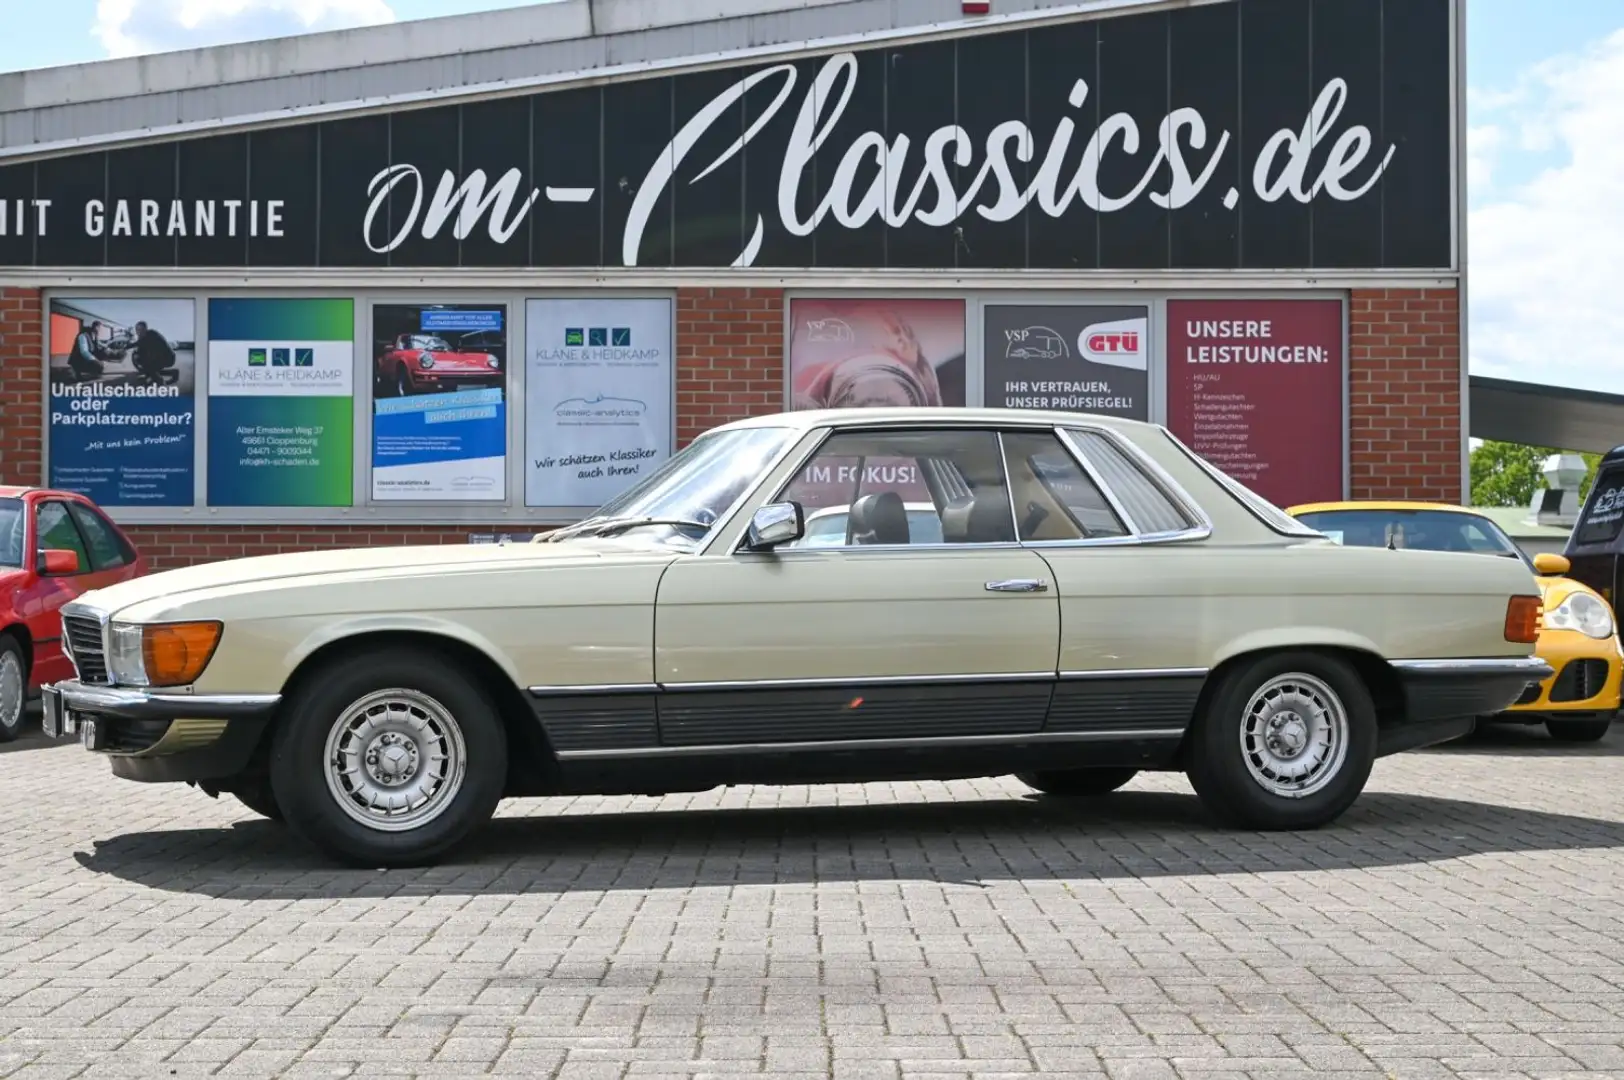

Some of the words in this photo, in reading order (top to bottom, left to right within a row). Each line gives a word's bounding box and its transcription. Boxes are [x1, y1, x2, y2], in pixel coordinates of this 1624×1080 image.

[363, 52, 1396, 267] om-Classics.de
[0, 199, 51, 236] IT
[85, 199, 284, 237] GARANTIE
[1004, 330, 1030, 341] VSP
[1186, 320, 1272, 338] UNSERE
[1088, 332, 1138, 352] GTÜ
[581, 350, 590, 361] &
[593, 349, 660, 361] HEIDKAMP
[1187, 346, 1329, 363] LEISTUNGEN:
[264, 370, 273, 381] &
[276, 370, 343, 381] HEIDKAMP
[51, 382, 179, 398] Unfallschaden
[1005, 381, 1028, 393] IHR
[1031, 381, 1111, 394] VERTRAUEN,
[70, 397, 110, 411] oder
[1005, 397, 1049, 408] UNSER
[1052, 395, 1132, 408] PRÜFSIEGEL!
[52, 412, 192, 427] Parkplatzrempler?
[295, 426, 312, 436] Weg
[106, 440, 121, 448] uns
[123, 438, 142, 447] kein
[266, 436, 319, 447] Cloppenburg
[535, 458, 555, 469] Wir
[559, 455, 605, 466] schätzen
[609, 448, 657, 461] Klassiker
[578, 467, 603, 479] auch
[607, 464, 640, 476] Ihren!
[805, 466, 831, 483] IM
